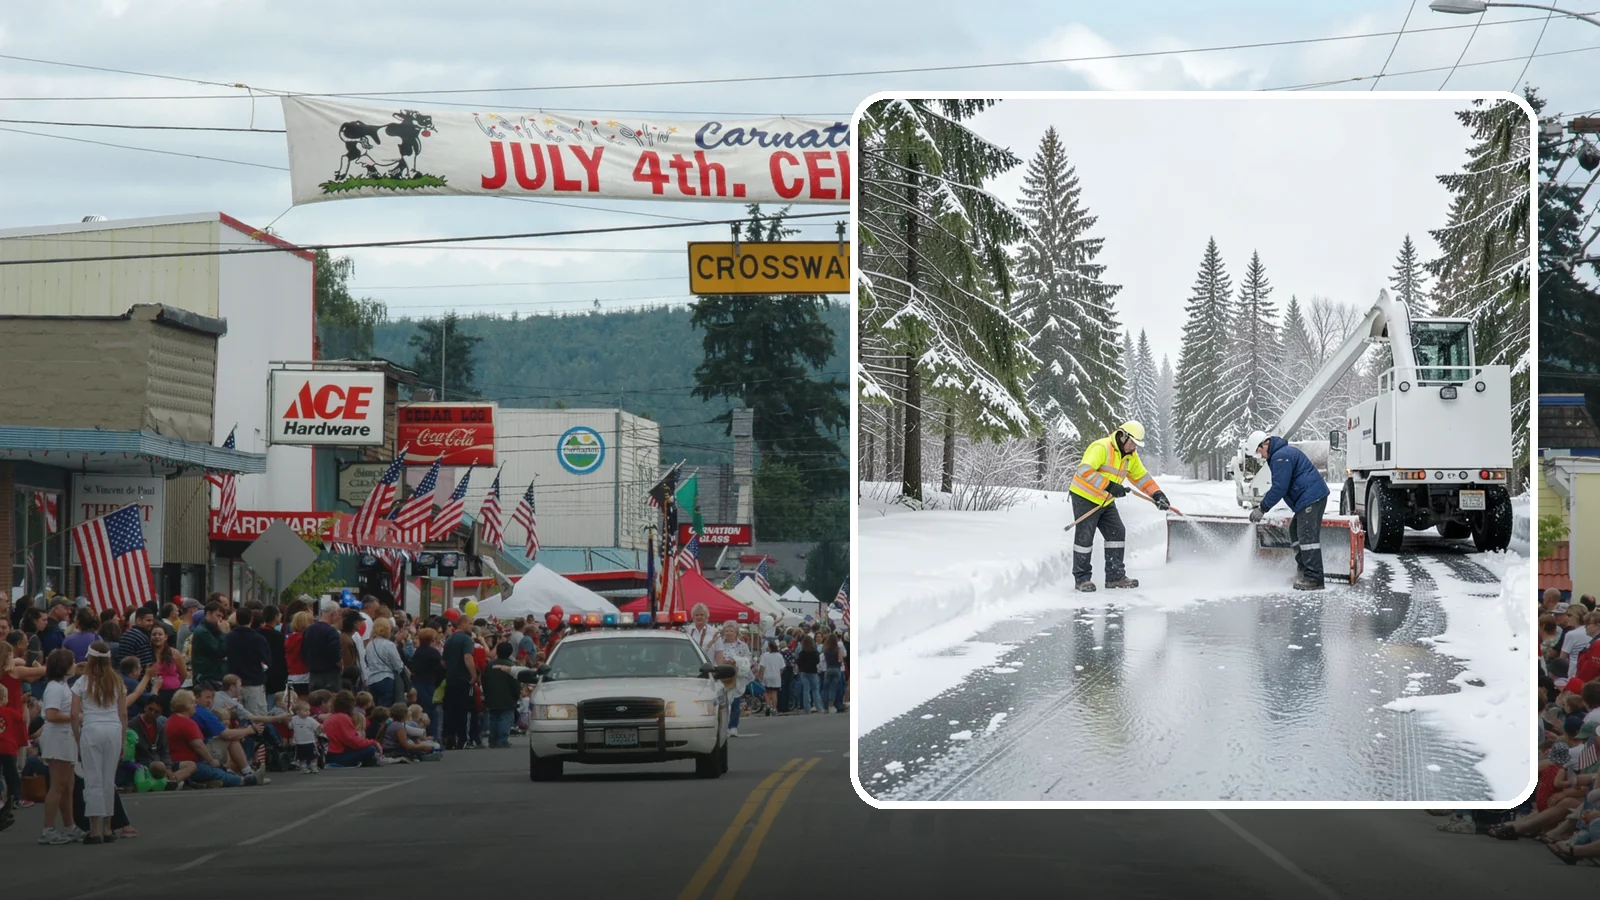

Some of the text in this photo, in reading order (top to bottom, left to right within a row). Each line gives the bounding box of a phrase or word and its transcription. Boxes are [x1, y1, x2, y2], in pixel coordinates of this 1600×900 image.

[481, 141, 604, 192] JULY
[632, 150, 746, 198] 4th.
[697, 254, 850, 280] CROSSWA
[282, 380, 373, 420] ACE
[406, 409, 452, 421] CEDAR
[283, 421, 370, 436] Hardware
[416, 428, 477, 447] Coca-Cola
[83, 485, 155, 495] St. Vincent de Paul
[688, 526, 741, 535] CRNATION
[699, 535, 730, 543] GLASS
